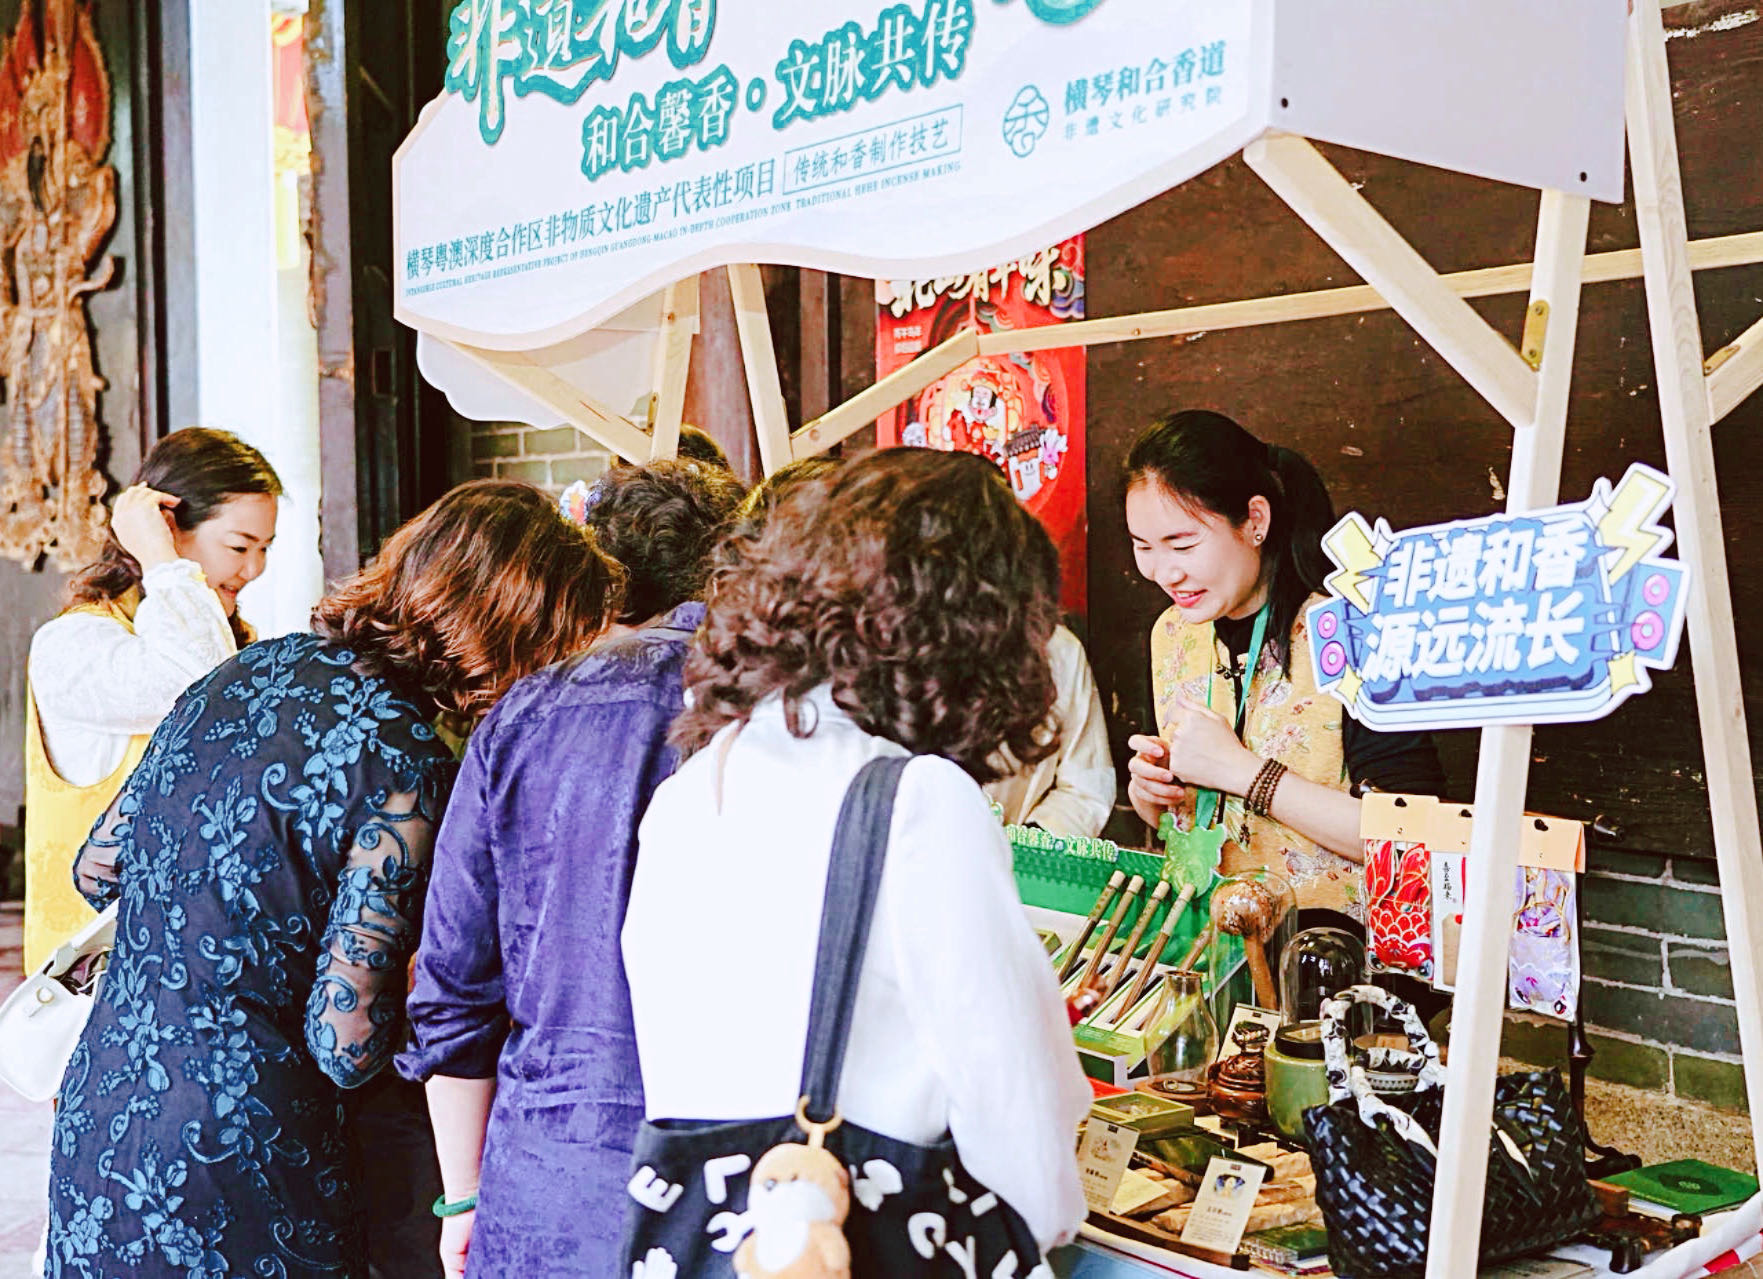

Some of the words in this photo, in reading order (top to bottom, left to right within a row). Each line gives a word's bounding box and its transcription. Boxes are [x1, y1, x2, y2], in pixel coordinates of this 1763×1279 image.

[716, 206, 768, 228] COOPERATION
[796, 187, 851, 209] TRADITIONAL
[881, 170, 919, 190] INCENSE
[922, 160, 961, 179] MAKING
[793, 118, 949, 185] 传统和香制作技艺
[406, 157, 776, 281] 横琴粤澳深度合作区非物质文化遗产代表性项目
[1383, 518, 1589, 607] 非遗和香
[1361, 590, 1585, 683] 源远流长
